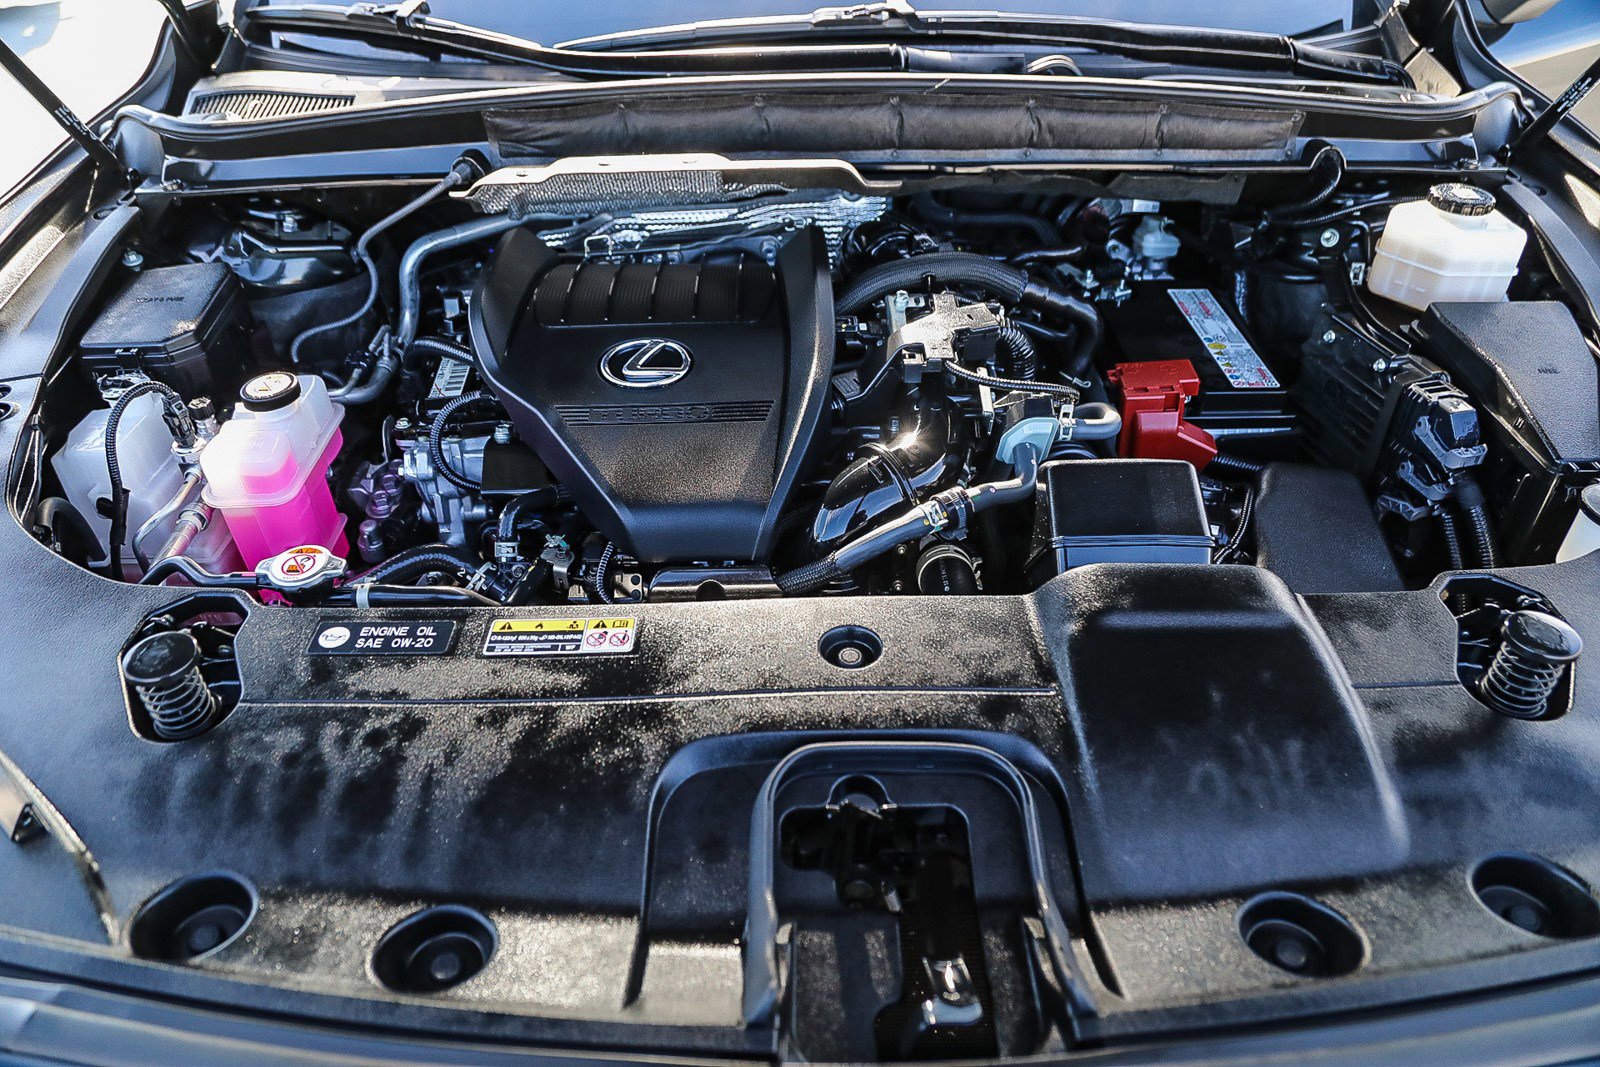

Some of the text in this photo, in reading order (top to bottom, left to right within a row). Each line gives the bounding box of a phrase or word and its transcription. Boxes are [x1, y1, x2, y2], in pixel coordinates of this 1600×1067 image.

[360, 626, 437, 636] ENGINE OIL
[355, 638, 434, 648] SAE 0W-20
